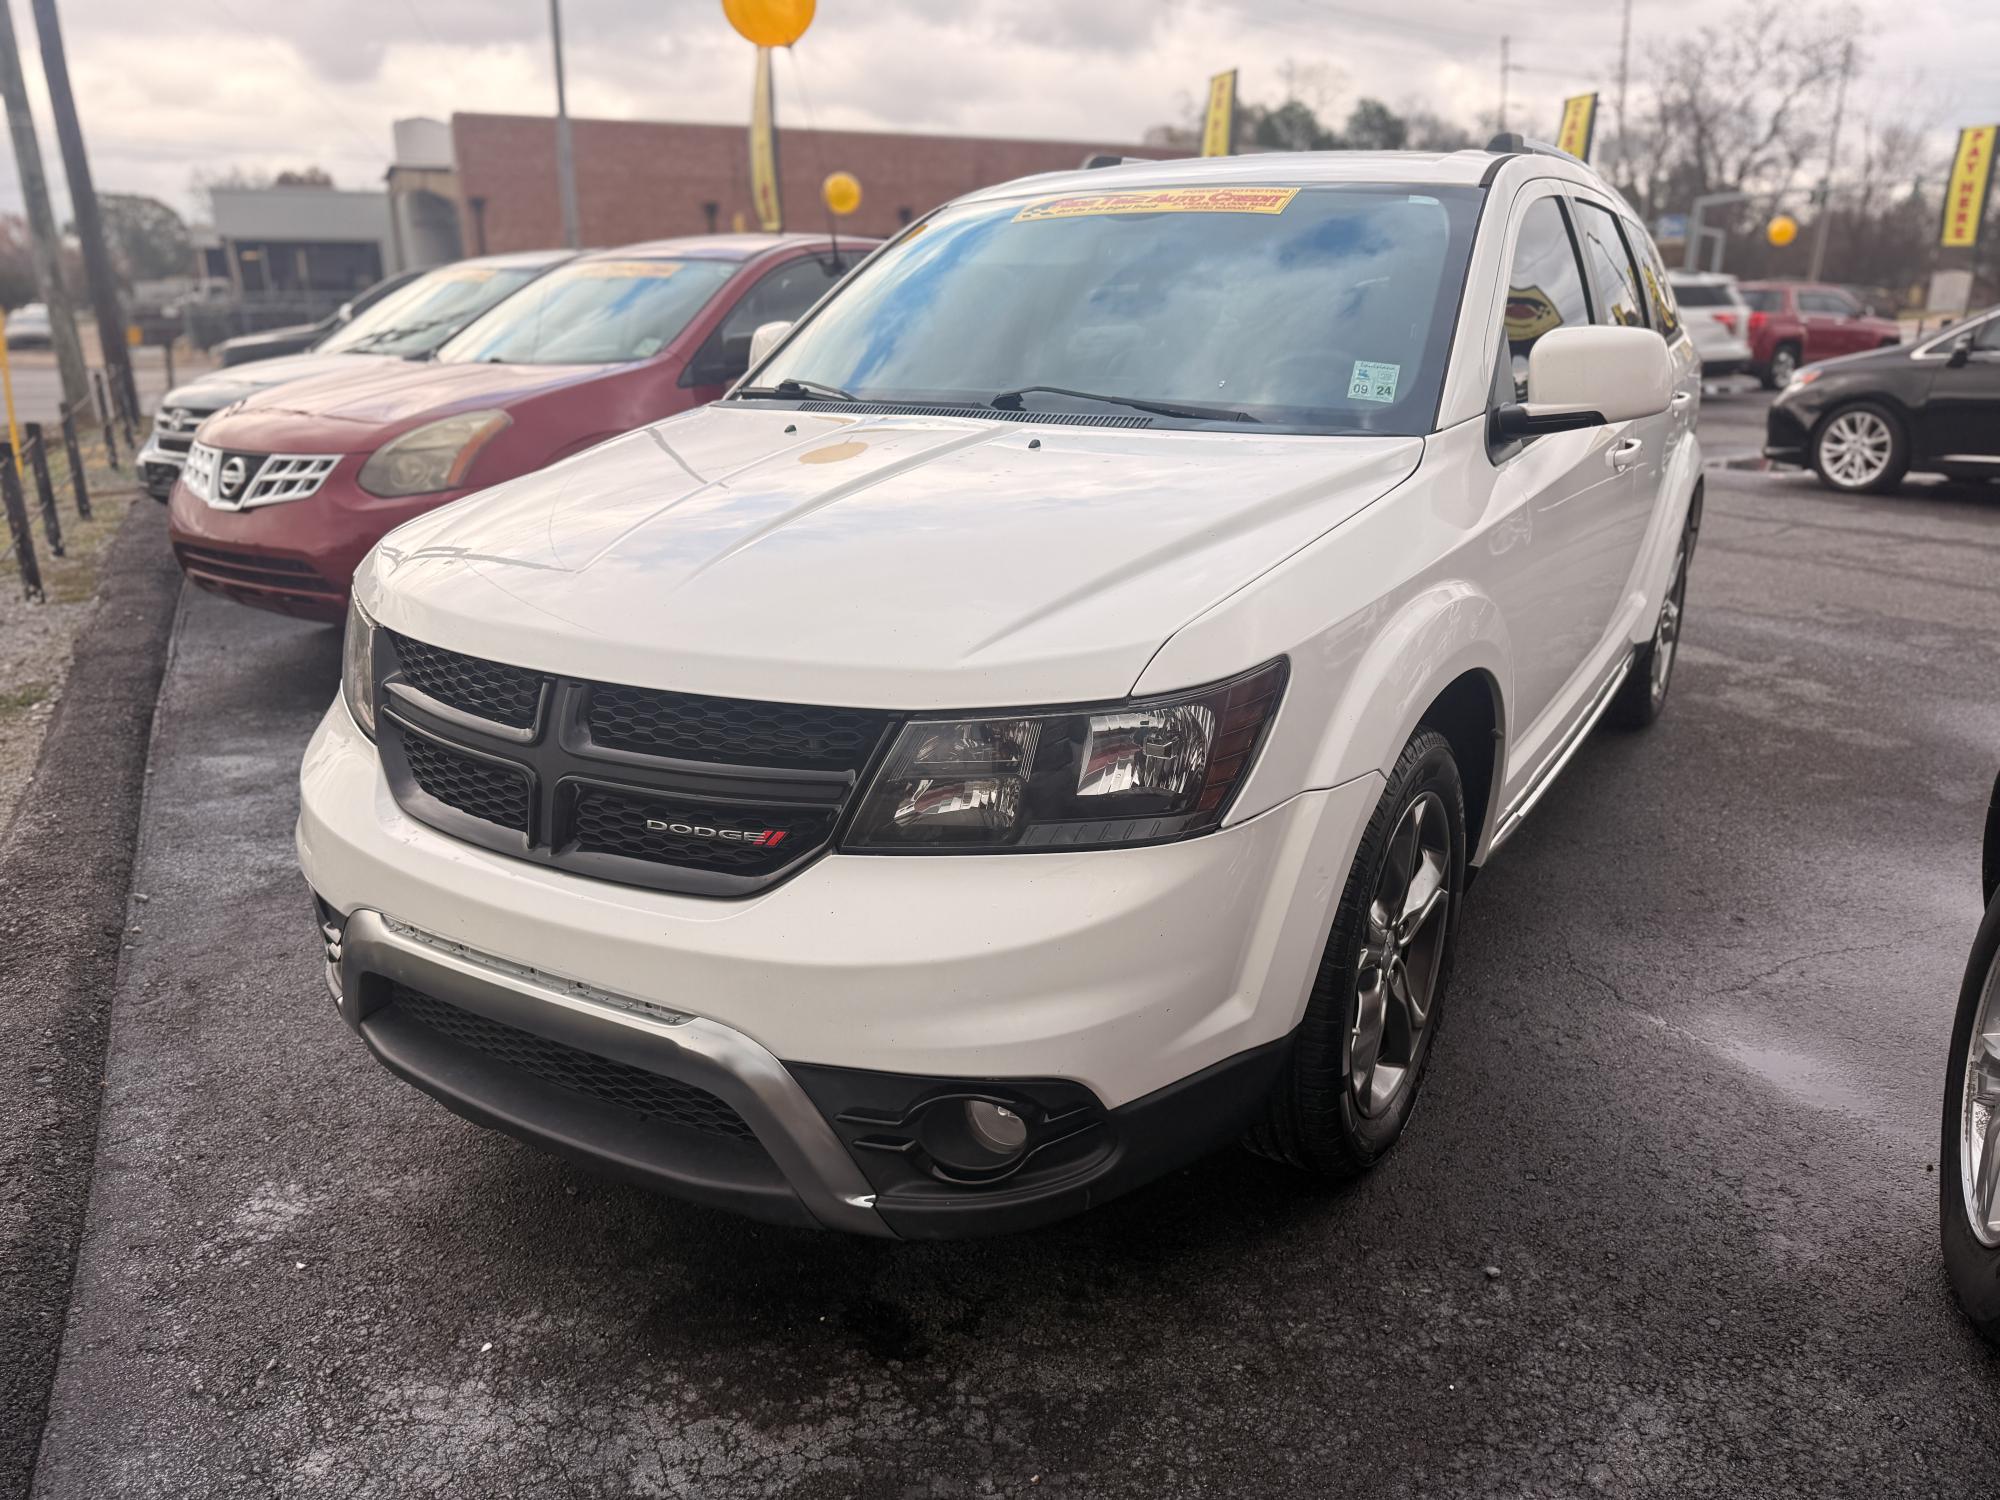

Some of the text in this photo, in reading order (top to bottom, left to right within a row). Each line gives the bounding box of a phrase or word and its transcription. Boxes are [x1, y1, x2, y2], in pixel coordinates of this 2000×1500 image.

[1953, 129, 1984, 239] PAY HERE
[1353, 384, 1392, 396] 09 24
[646, 819, 767, 843] DODGE
